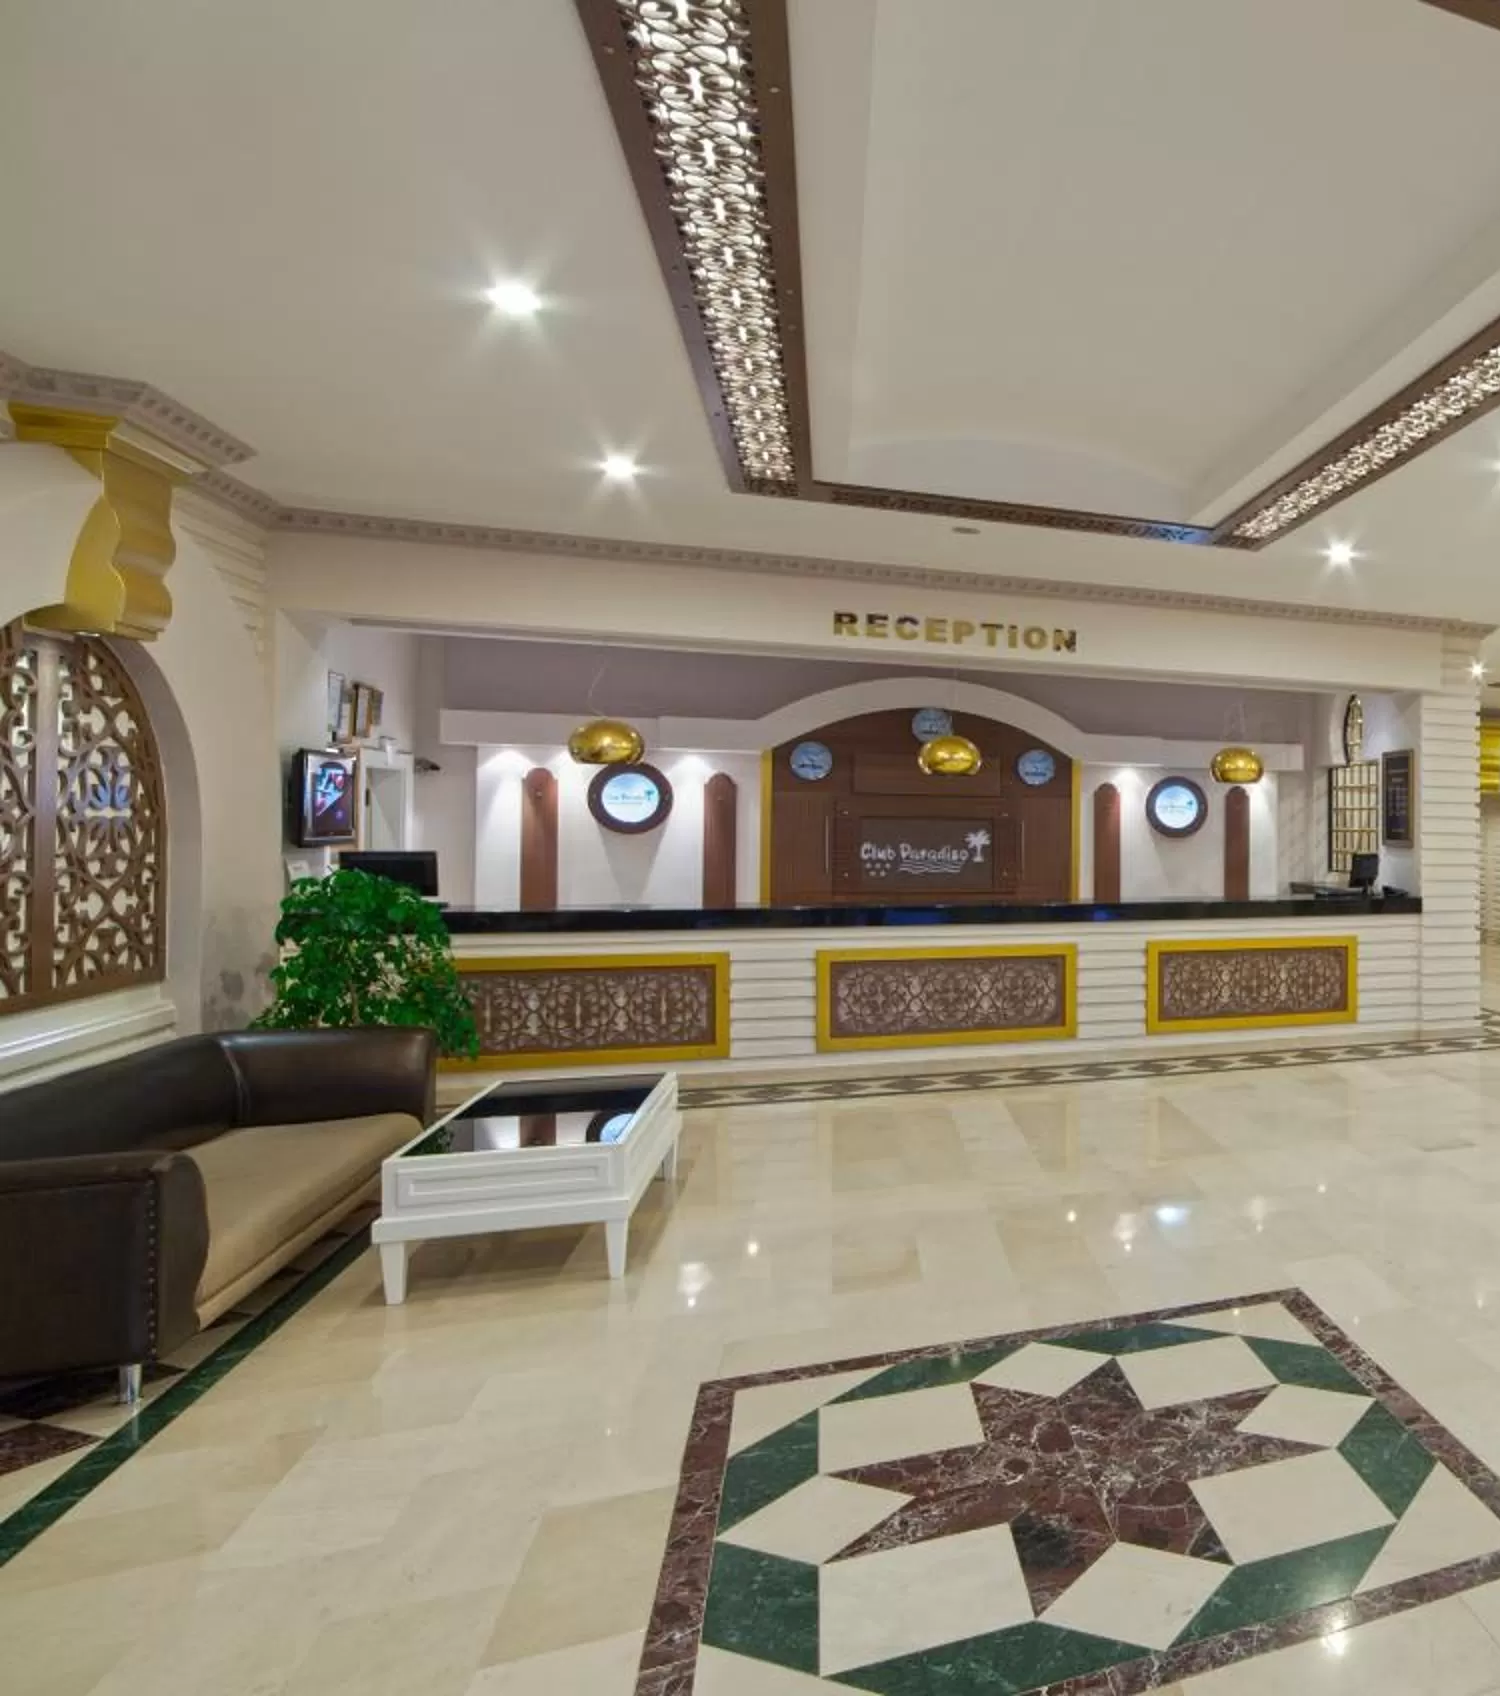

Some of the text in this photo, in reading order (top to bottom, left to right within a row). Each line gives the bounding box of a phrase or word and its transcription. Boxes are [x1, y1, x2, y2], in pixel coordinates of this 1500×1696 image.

[833, 611, 1077, 652] RECEPTION
[860, 842, 969, 861] Club Paradiso
